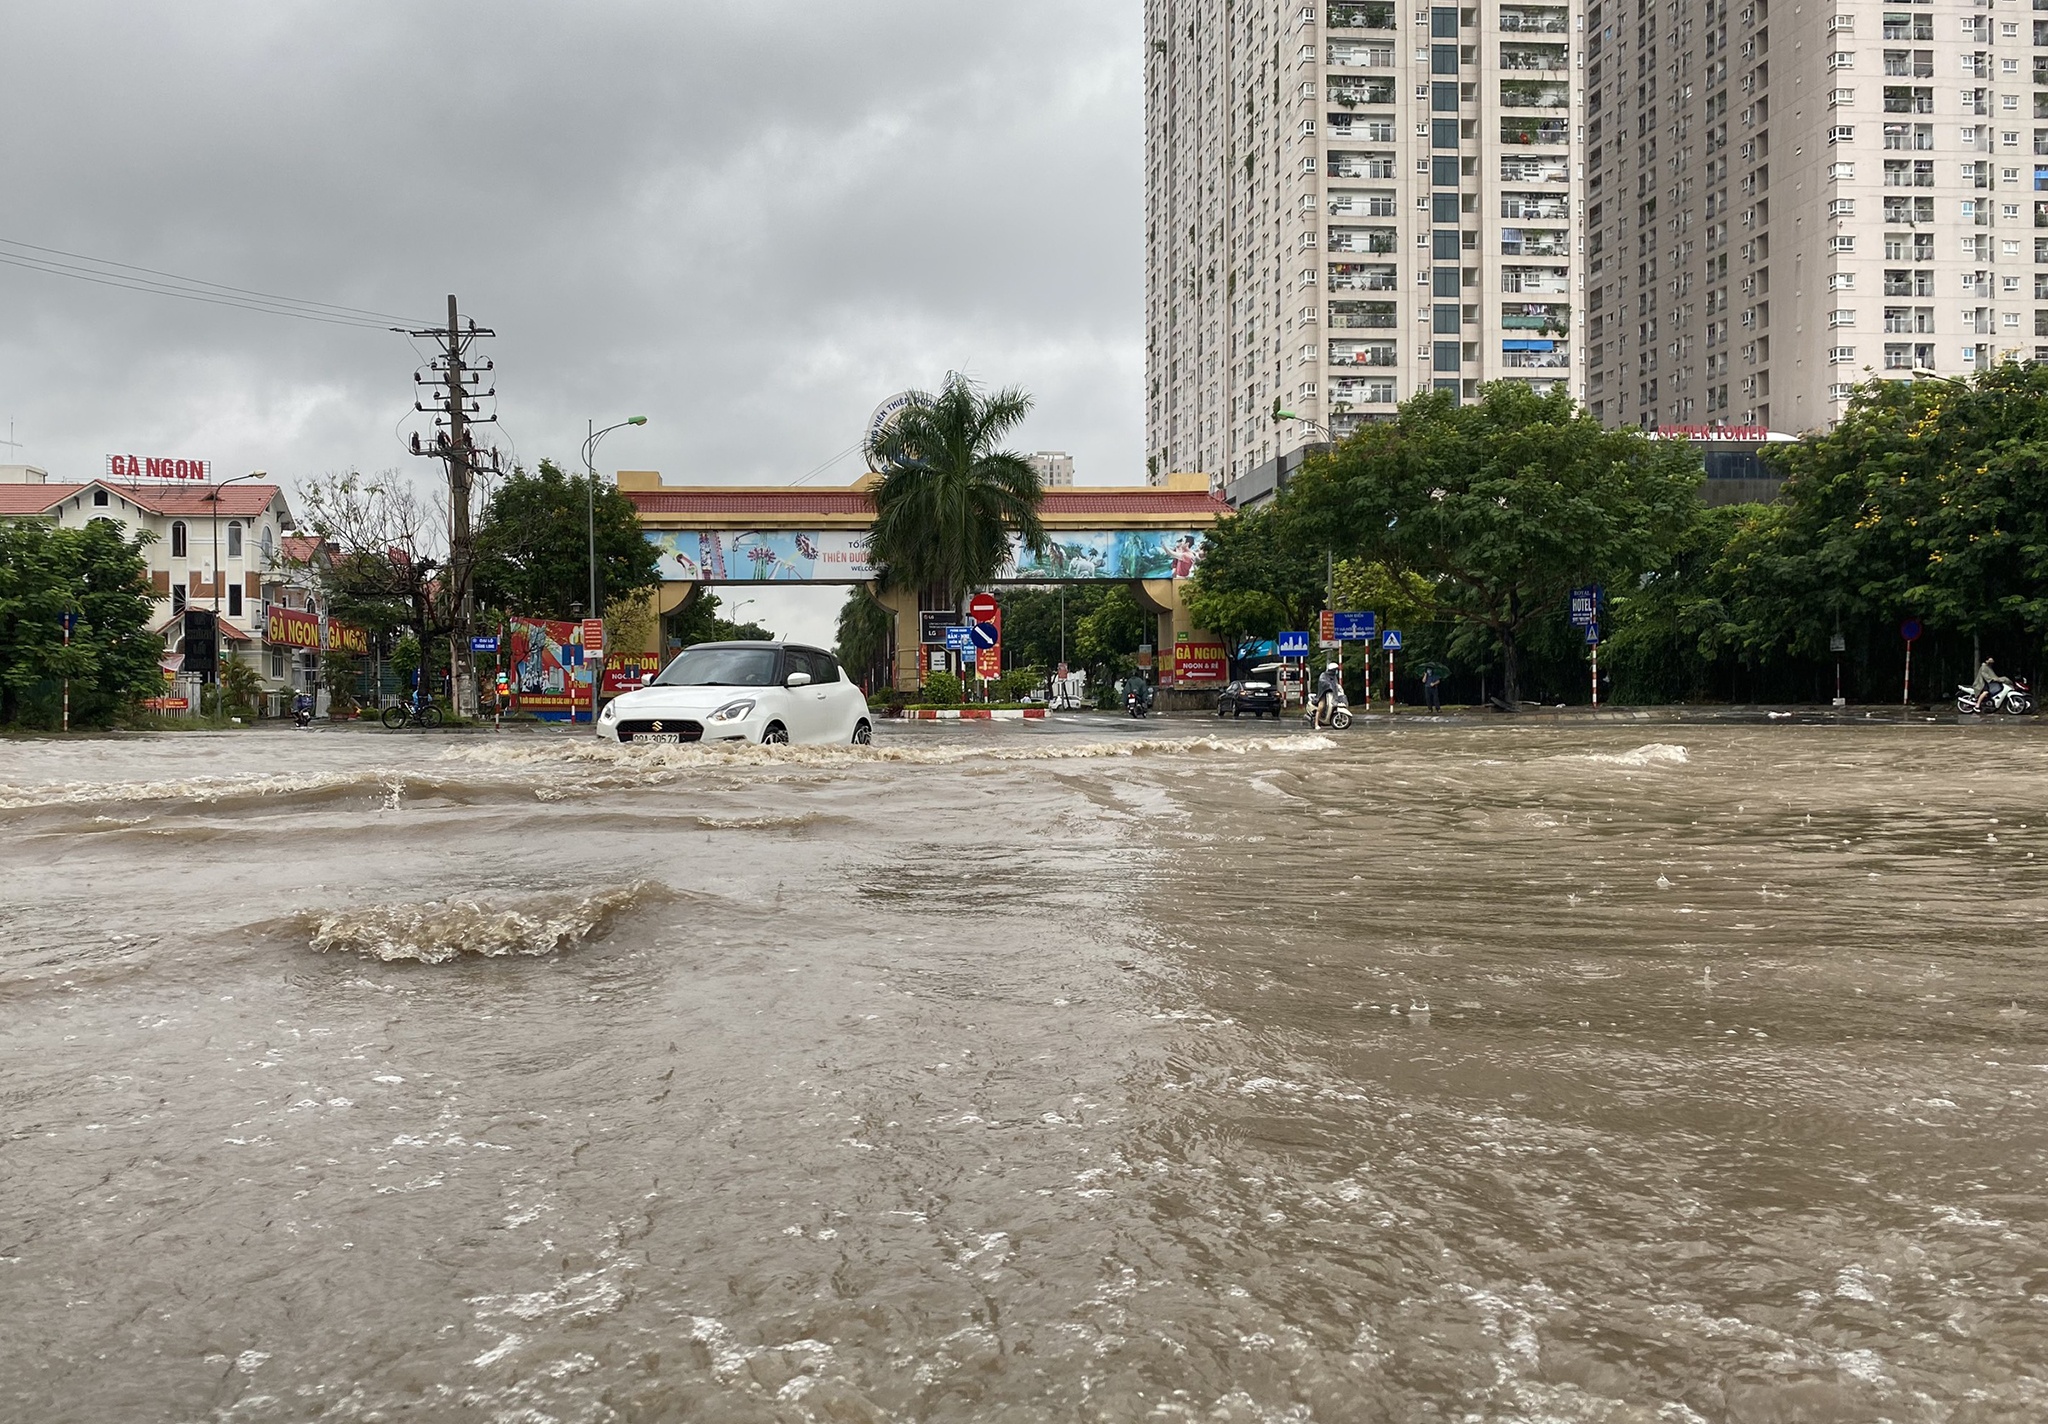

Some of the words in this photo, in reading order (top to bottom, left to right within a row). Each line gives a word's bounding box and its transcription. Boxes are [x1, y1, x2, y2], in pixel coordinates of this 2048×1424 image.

[1715, 425, 1768, 440] TOWER
[146, 457, 204, 480] NGON
[823, 551, 847, 563] THIÊN
[1573, 598, 1592, 612] HOTEL
[269, 610, 286, 642] GÀ
[288, 619, 319, 647] NGON
[328, 621, 342, 649] GÀ
[1176, 645, 1191, 660] GÀ
[1194, 647, 1225, 660] NGON
